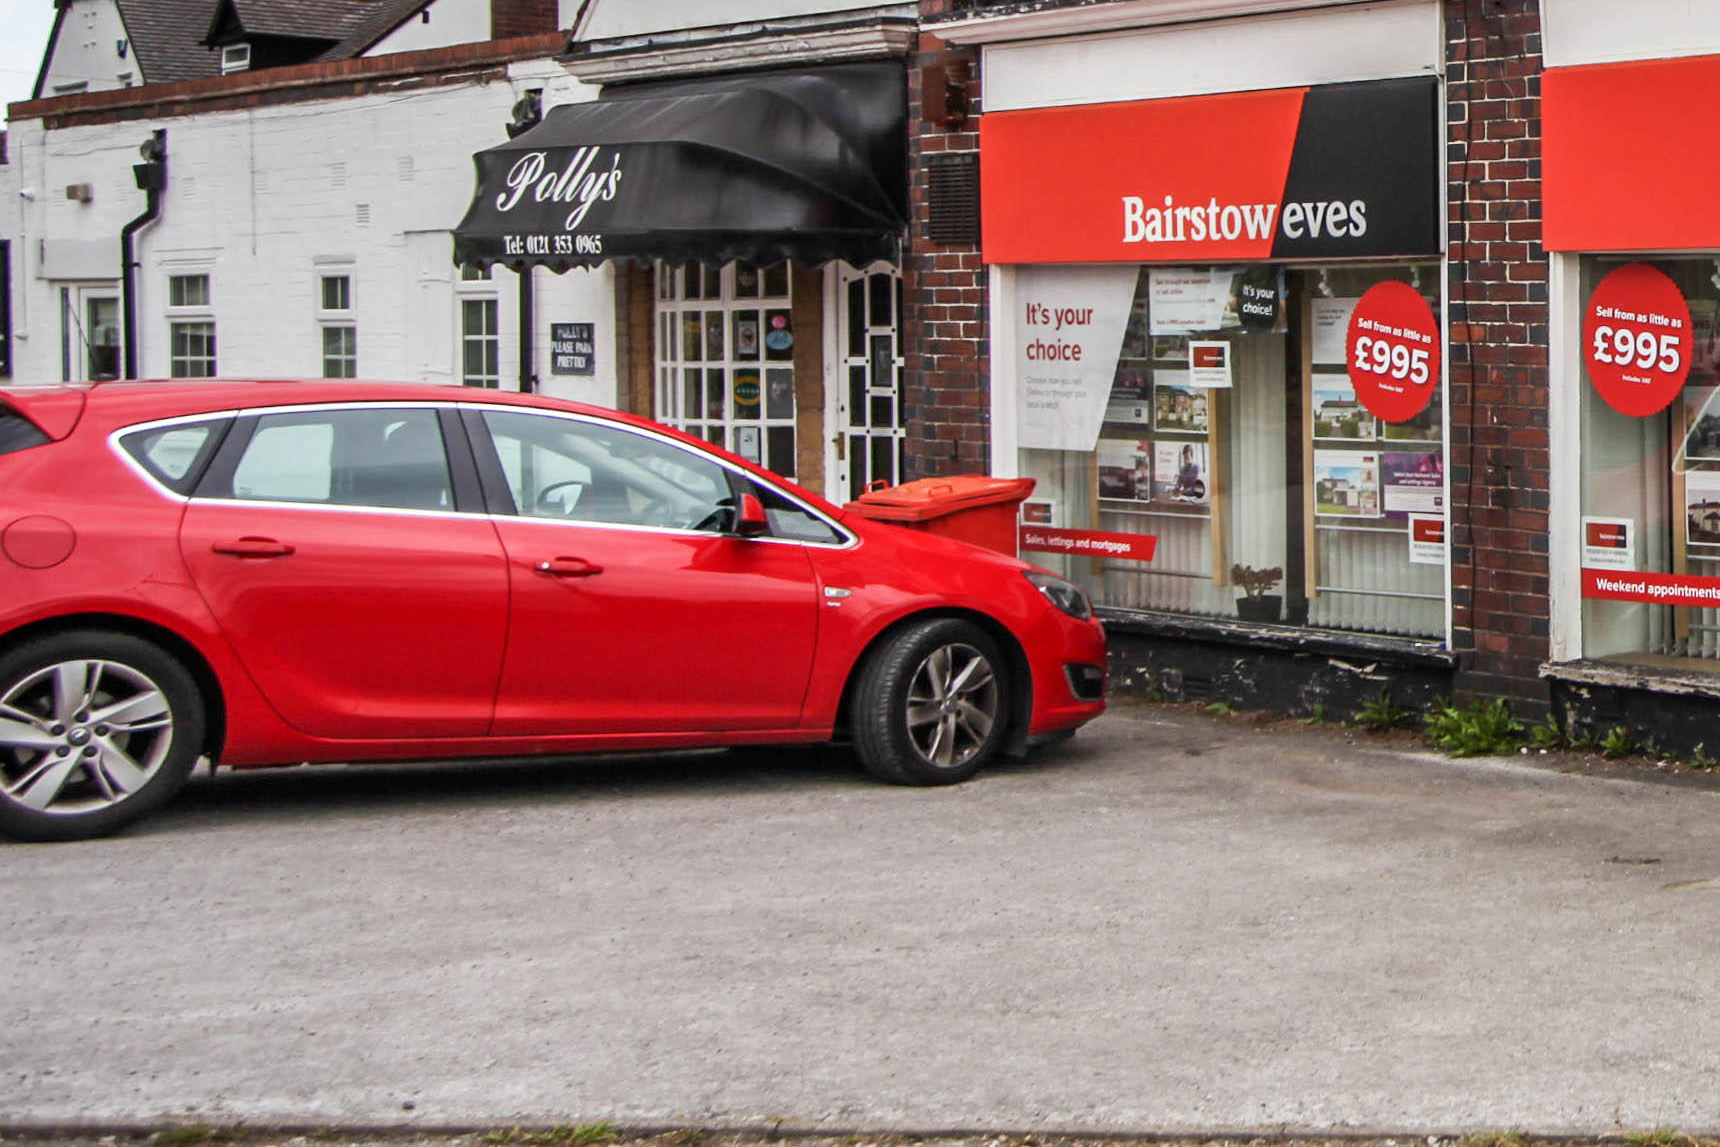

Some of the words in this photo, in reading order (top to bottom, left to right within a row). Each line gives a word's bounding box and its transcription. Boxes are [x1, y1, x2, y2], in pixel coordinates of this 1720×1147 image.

[496, 145, 622, 231] Polly's
[1122, 194, 1278, 243] Bairstow
[1282, 199, 1367, 240] eves
[503, 235, 524, 255] Tel:
[526, 235, 550, 254] 0121
[553, 235, 573, 254] 353
[575, 234, 602, 254] 0965
[1243, 284, 1255, 296] It's
[1256, 288, 1275, 300] your
[1026, 302, 1051, 325] It's
[1054, 307, 1094, 331] your
[1242, 302, 1273, 316] choice!
[1596, 306, 1613, 318] Sell
[1614, 308, 1636, 322] from
[1636, 314, 1648, 323] as
[1649, 313, 1669, 327] little
[1670, 319, 1682, 328] as
[1357, 317, 1373, 330] Sell
[1373, 321, 1392, 334] from
[1392, 328, 1402, 337] as
[1403, 328, 1421, 341] little
[1421, 335, 1432, 344] as
[1026, 337, 1082, 361] choice
[1355, 336, 1430, 385] £995
[1593, 325, 1681, 373] £995
[1025, 534, 1047, 546] Sales,
[1047, 535, 1075, 549] lettings
[1076, 538, 1090, 548] and
[1091, 540, 1131, 553] mortgages
[1596, 577, 1646, 594] Weekend
